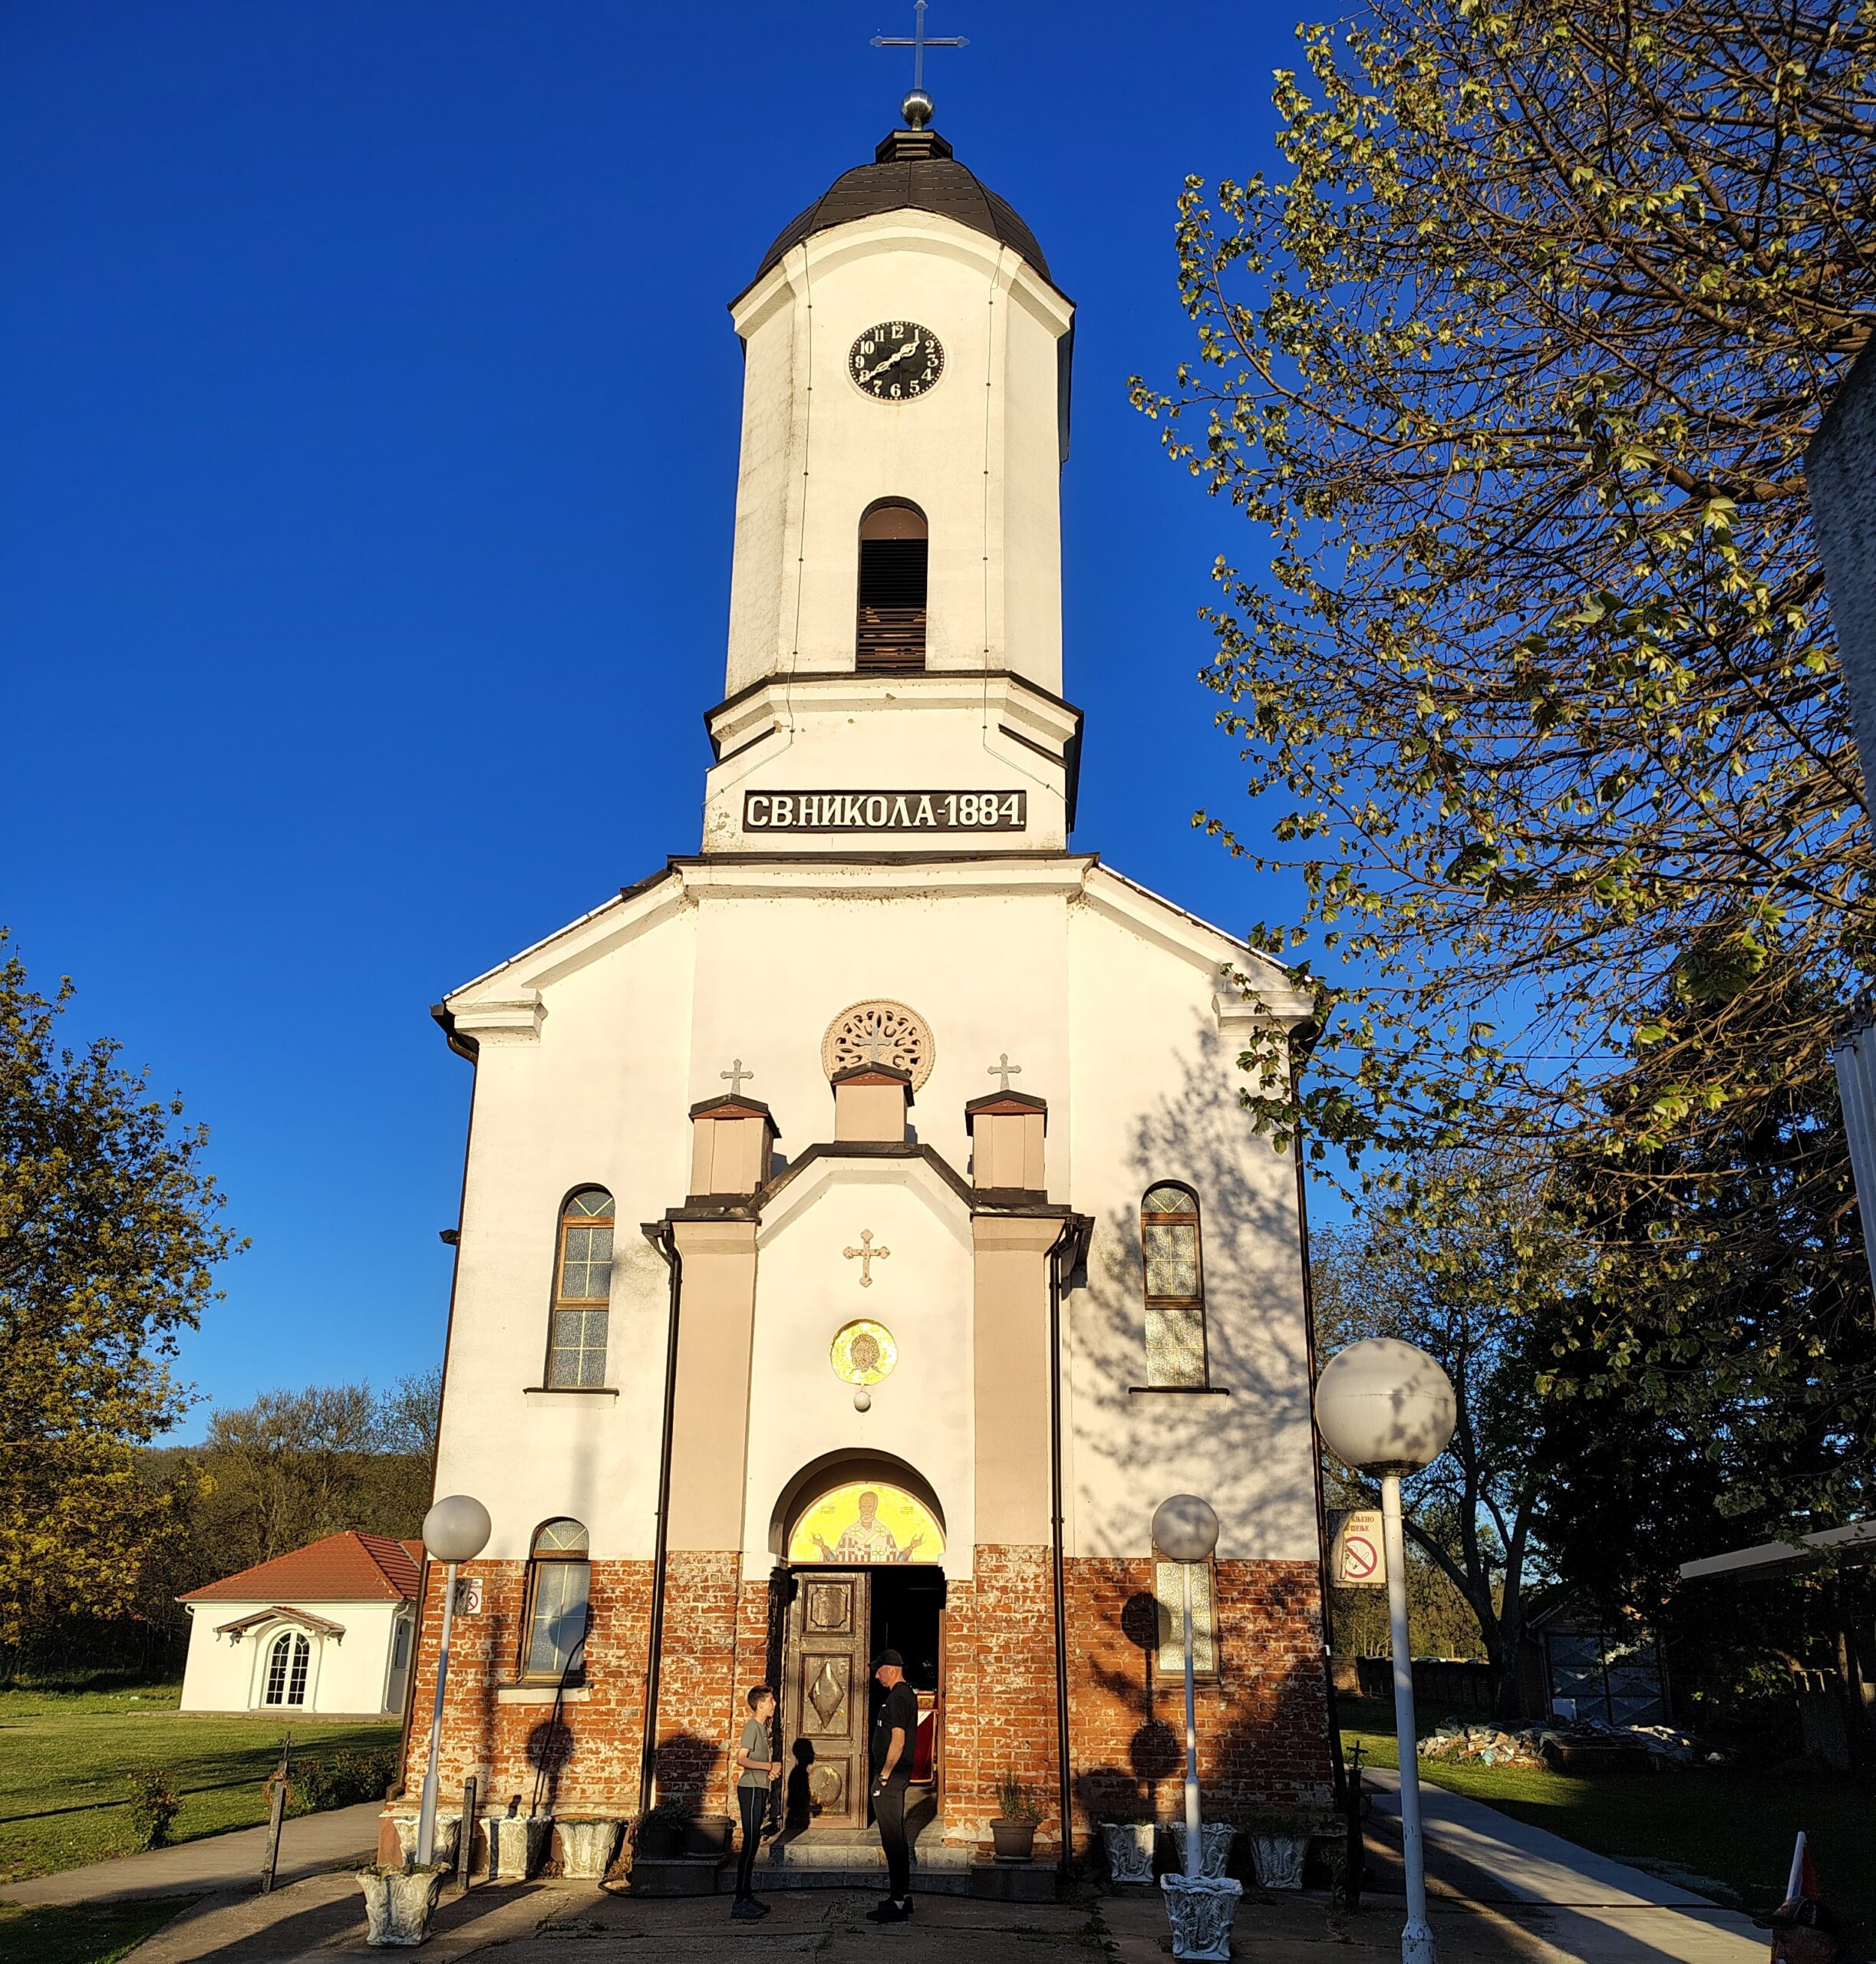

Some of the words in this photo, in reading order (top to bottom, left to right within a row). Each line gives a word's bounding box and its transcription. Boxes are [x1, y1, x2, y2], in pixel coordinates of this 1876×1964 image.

[875, 329, 885, 342] 11
[891, 325, 904, 339] 12
[914, 328, 919, 341] 1
[859, 341, 875, 354] 10
[925, 340, 935, 354] 2
[855, 355, 865, 368] 9
[927, 354, 939, 367] 3
[859, 370, 870, 383] 8
[922, 368, 935, 381] 4
[873, 380, 882, 394] 7
[890, 384, 901, 397] 6
[909, 380, 920, 394] 5
